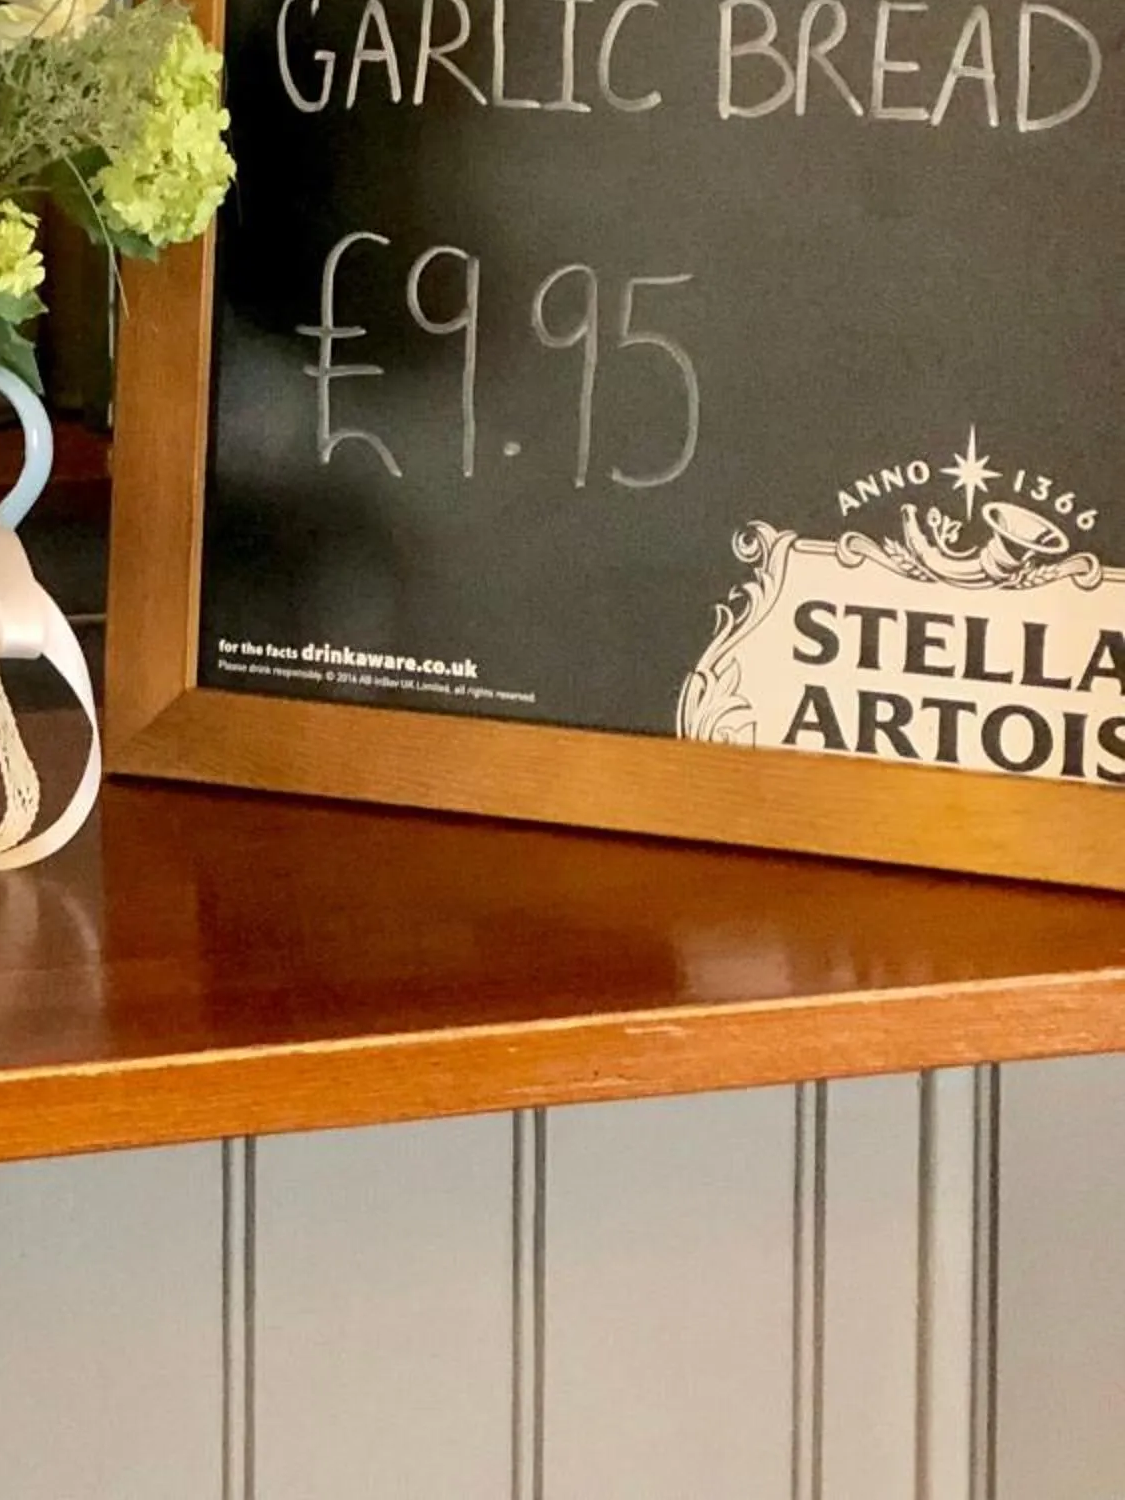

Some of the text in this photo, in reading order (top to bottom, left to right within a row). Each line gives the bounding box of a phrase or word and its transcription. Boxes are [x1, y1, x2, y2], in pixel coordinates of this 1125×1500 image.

[295, 231, 701, 489] £9.95
[837, 460, 1098, 530] ANNO 1366
[218, 639, 478, 678] for the facts drinkaware.co.uk
[792, 599, 1125, 696] STELLA
[781, 683, 1125, 783] ARTOIS
